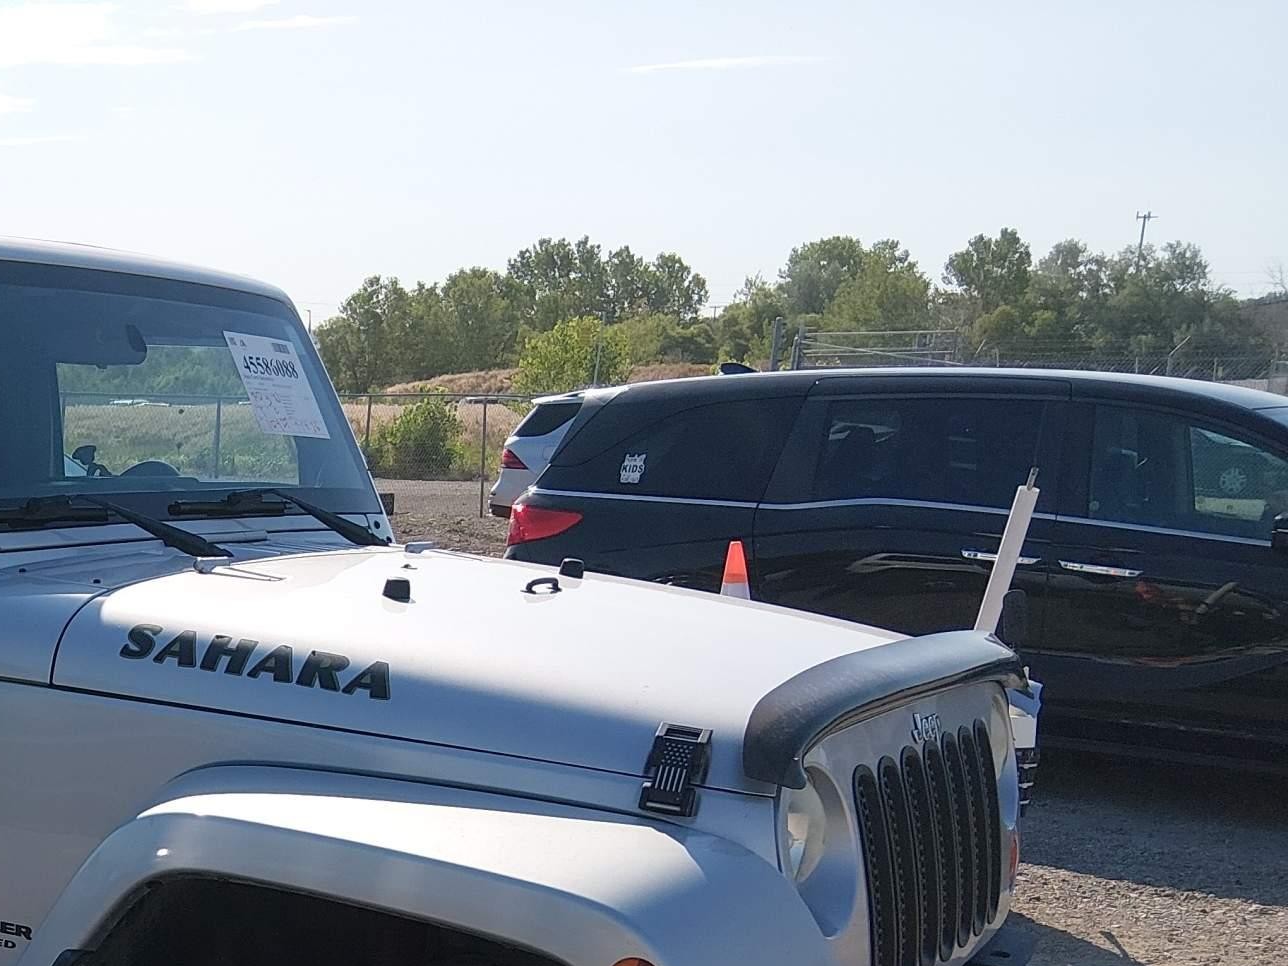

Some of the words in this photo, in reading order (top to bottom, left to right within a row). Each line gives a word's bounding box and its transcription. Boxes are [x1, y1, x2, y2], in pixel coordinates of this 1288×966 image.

[242, 354, 299, 380] 45586088
[621, 464, 645, 474] KIDS
[119, 623, 391, 700] SAHARA
[911, 712, 941, 744] Jeep
